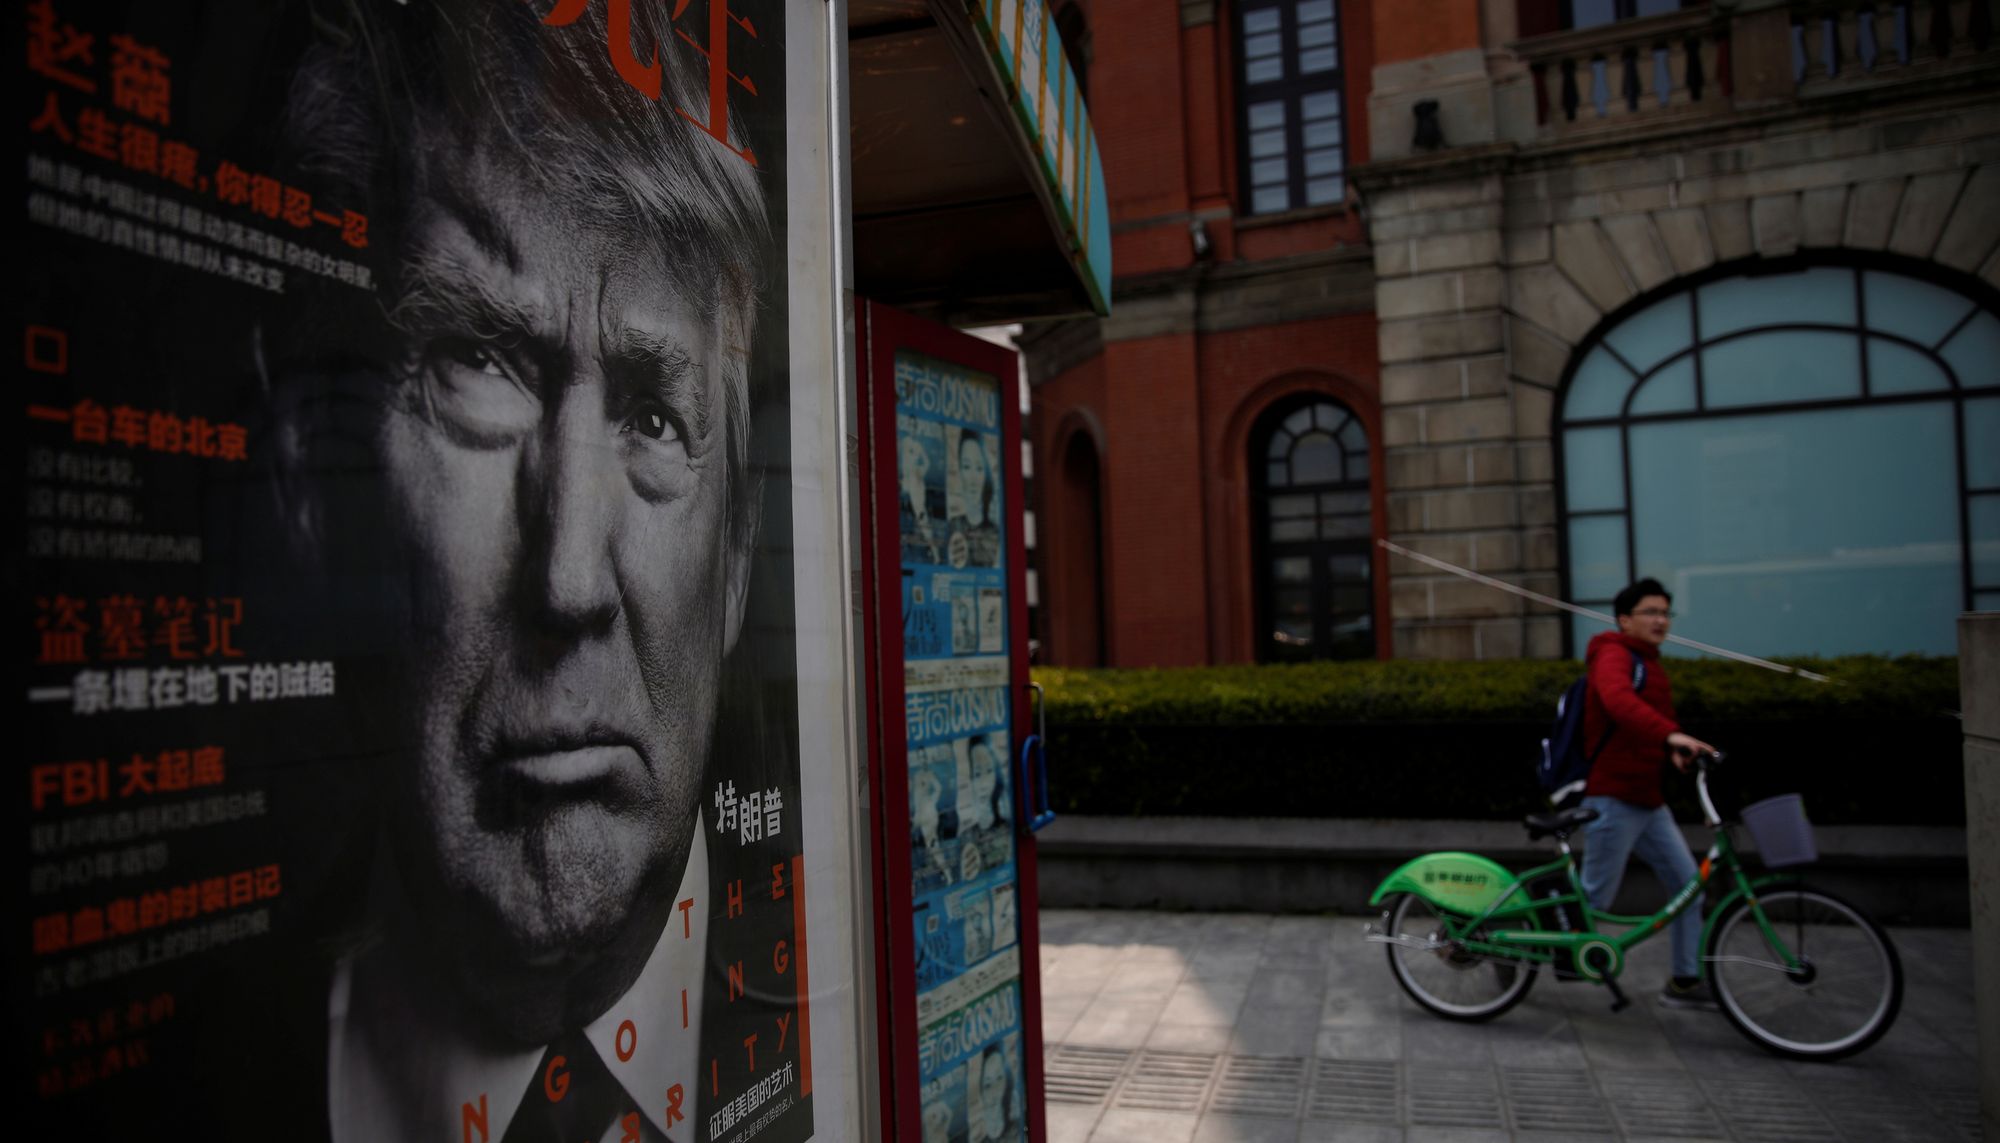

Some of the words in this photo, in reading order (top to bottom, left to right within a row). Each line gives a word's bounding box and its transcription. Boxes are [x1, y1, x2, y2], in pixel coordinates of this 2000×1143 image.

[25, 398, 249, 461] 一台车的北京
[33, 593, 246, 664] 盗墓笔记
[27, 660, 336, 716] 一条埋在地下的贼船
[30, 758, 112, 812] FBI
[118, 746, 226, 798] 大起底
[714, 780, 784, 846] 特朗普
[709, 1060, 793, 1142] 征服美国的艺术
